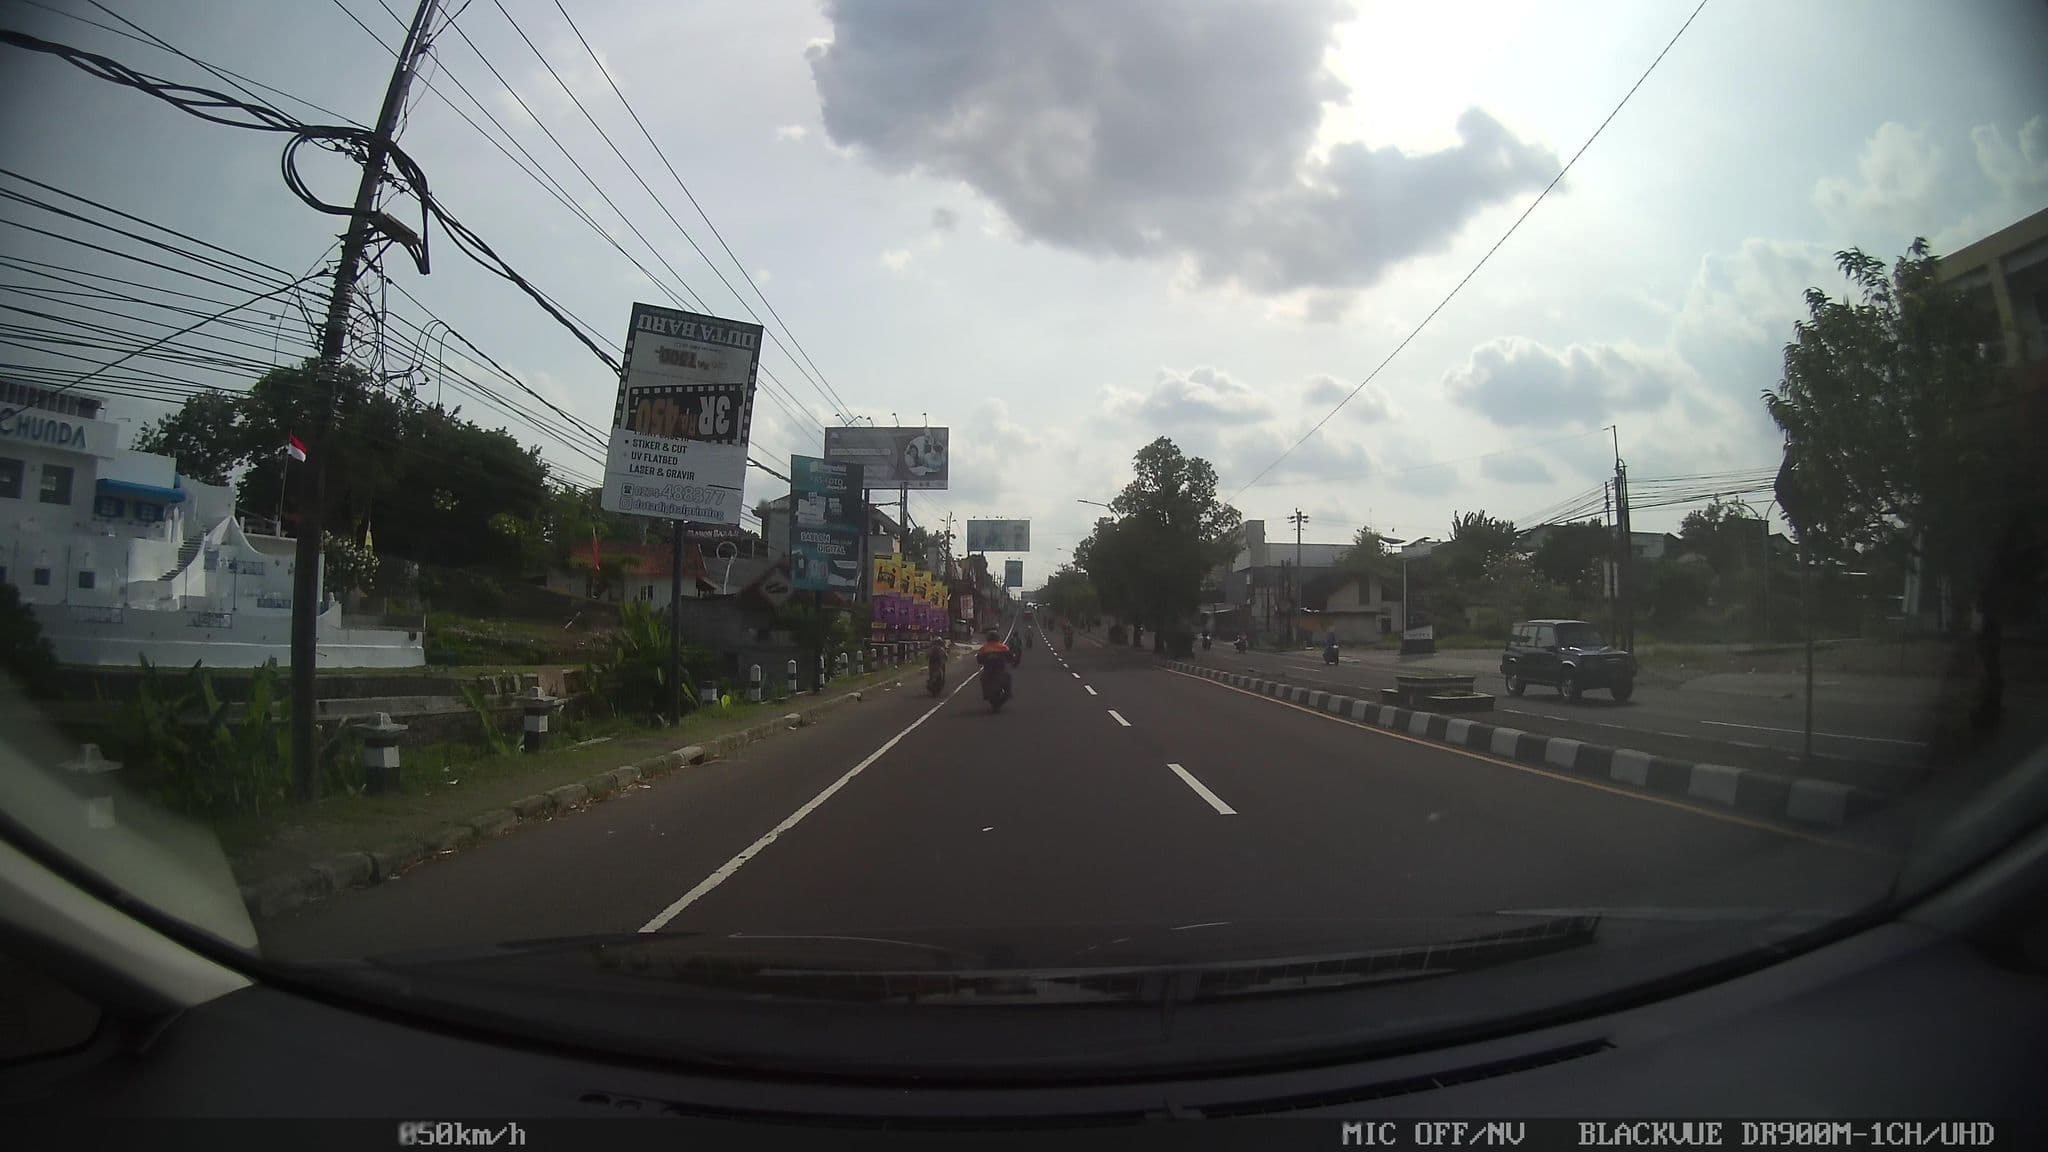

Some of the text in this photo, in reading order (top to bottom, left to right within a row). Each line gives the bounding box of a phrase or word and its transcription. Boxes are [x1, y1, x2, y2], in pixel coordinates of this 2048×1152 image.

[636, 313, 757, 347] DUTA BARU
[699, 395, 730, 436] 3R
[632, 438, 688, 455] STIKER & CUT
[631, 451, 678, 466] UV FLATBED
[629, 463, 655, 476] LASER
[656, 468, 664, 477] &
